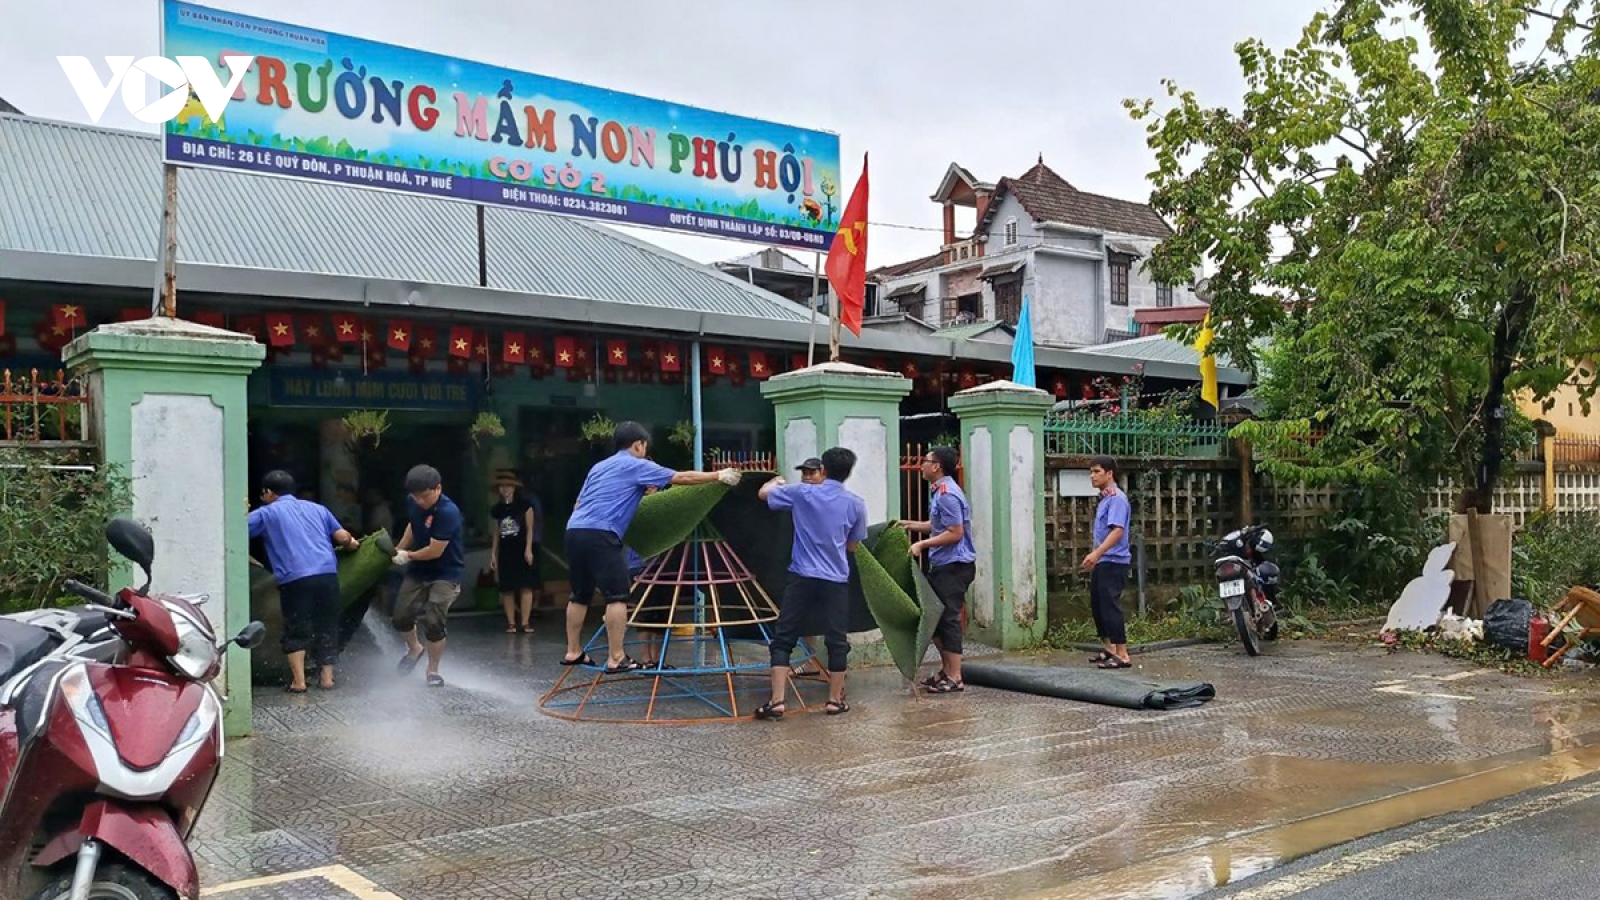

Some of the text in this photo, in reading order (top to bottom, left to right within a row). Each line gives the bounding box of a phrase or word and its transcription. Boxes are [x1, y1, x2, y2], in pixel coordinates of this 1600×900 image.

[453, 79, 557, 152] MẦM
[569, 113, 656, 169] NON
[668, 132, 743, 182] PHÚ
[754, 143, 815, 205] HỘI
[182, 141, 205, 158] ĐỊA
[208, 144, 236, 161] CHỈ:
[257, 152, 272, 166] LÊ
[275, 155, 299, 169] QUÝ
[302, 158, 331, 175] ĐÔN,
[334, 163, 342, 175] P
[345, 165, 383, 182] THUẬN
[414, 174, 429, 187] TP
[431, 175, 453, 190] HUẾ
[488, 156, 607, 193] CƠ SỞ 2
[502, 187, 527, 202] ĐIỆN
[528, 191, 561, 208] THOẠI:
[670, 212, 696, 226] QUYẾT
